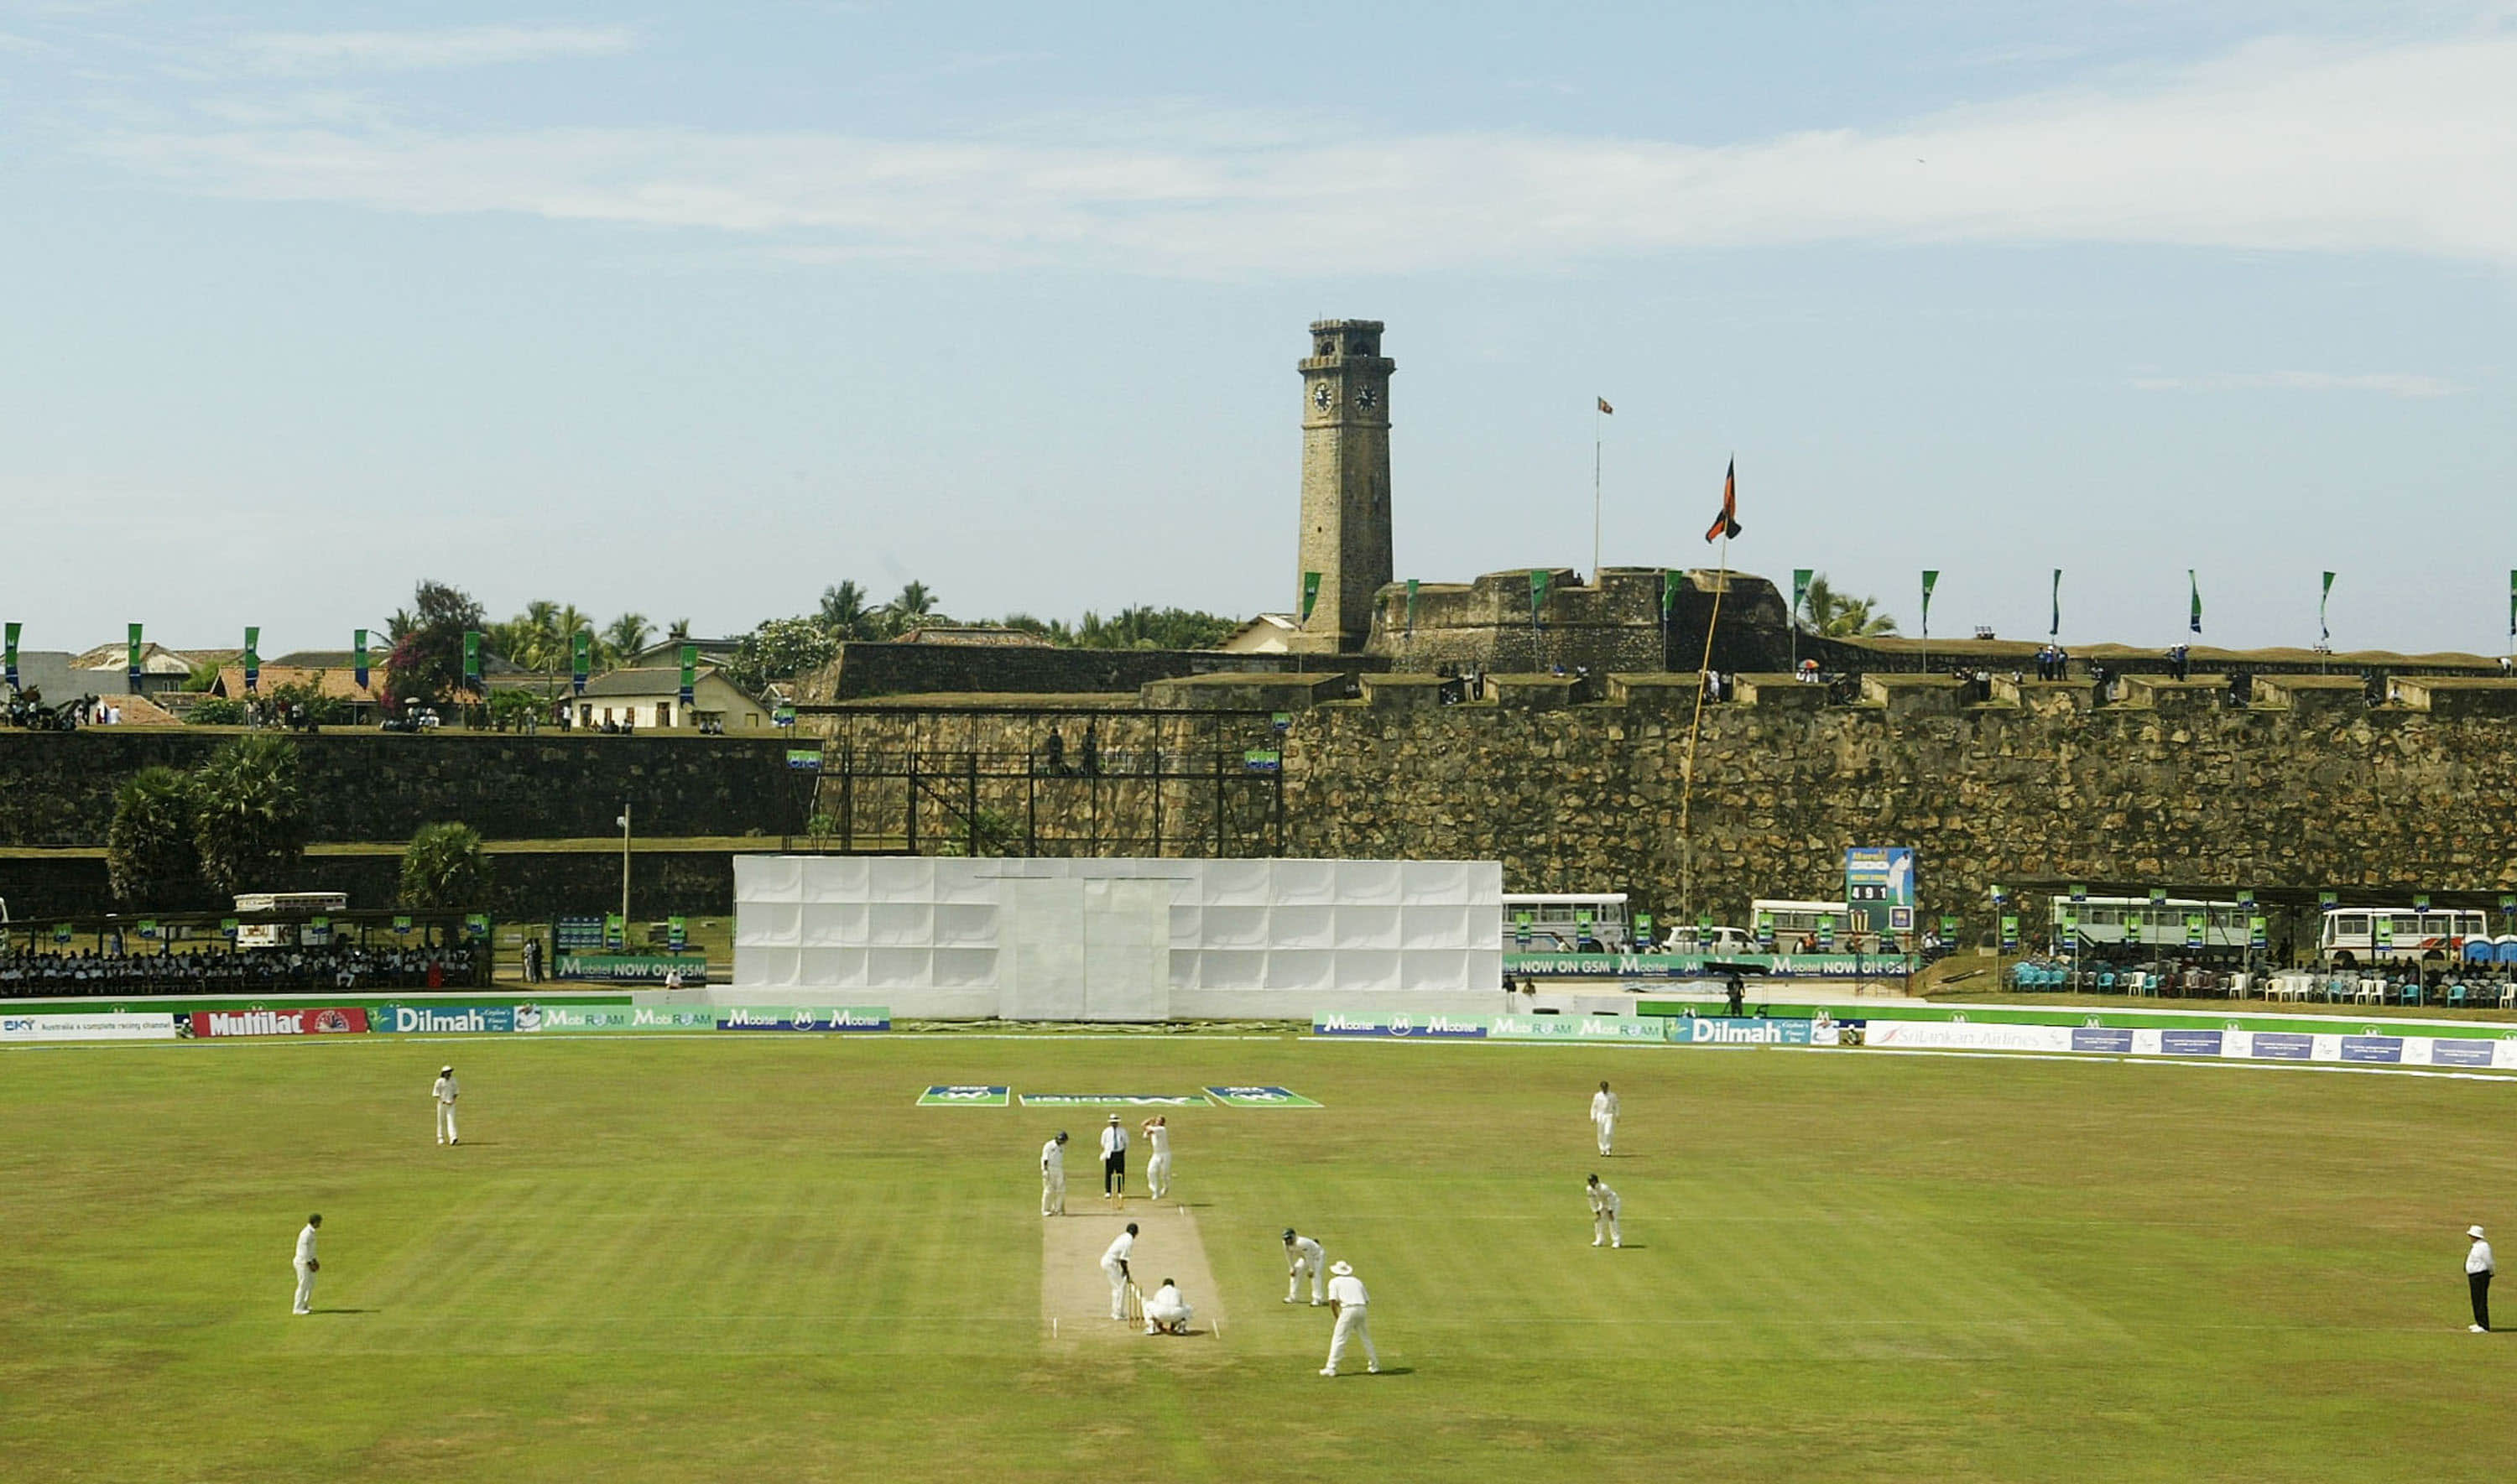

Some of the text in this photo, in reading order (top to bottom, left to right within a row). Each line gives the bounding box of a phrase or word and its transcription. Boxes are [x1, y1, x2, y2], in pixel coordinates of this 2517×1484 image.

[559, 958, 611, 976] Mobitel
[614, 964, 648, 976] NOW
[678, 964, 706, 976] GSM
[1520, 962, 1554, 973] NOW
[1558, 962, 1578, 973] ON
[1582, 962, 1611, 973] GSM
[1823, 962, 1856, 973] NOW
[209, 1011, 305, 1036] Multilac
[396, 1008, 485, 1032] Dilmah
[727, 1009, 778, 1027] Mobitel
[829, 1009, 880, 1028] Mobitel
[1324, 1013, 1375, 1031] Mobitel
[1426, 1016, 1477, 1034] Mobitel
[1692, 1018, 1781, 1043] Dilmah
